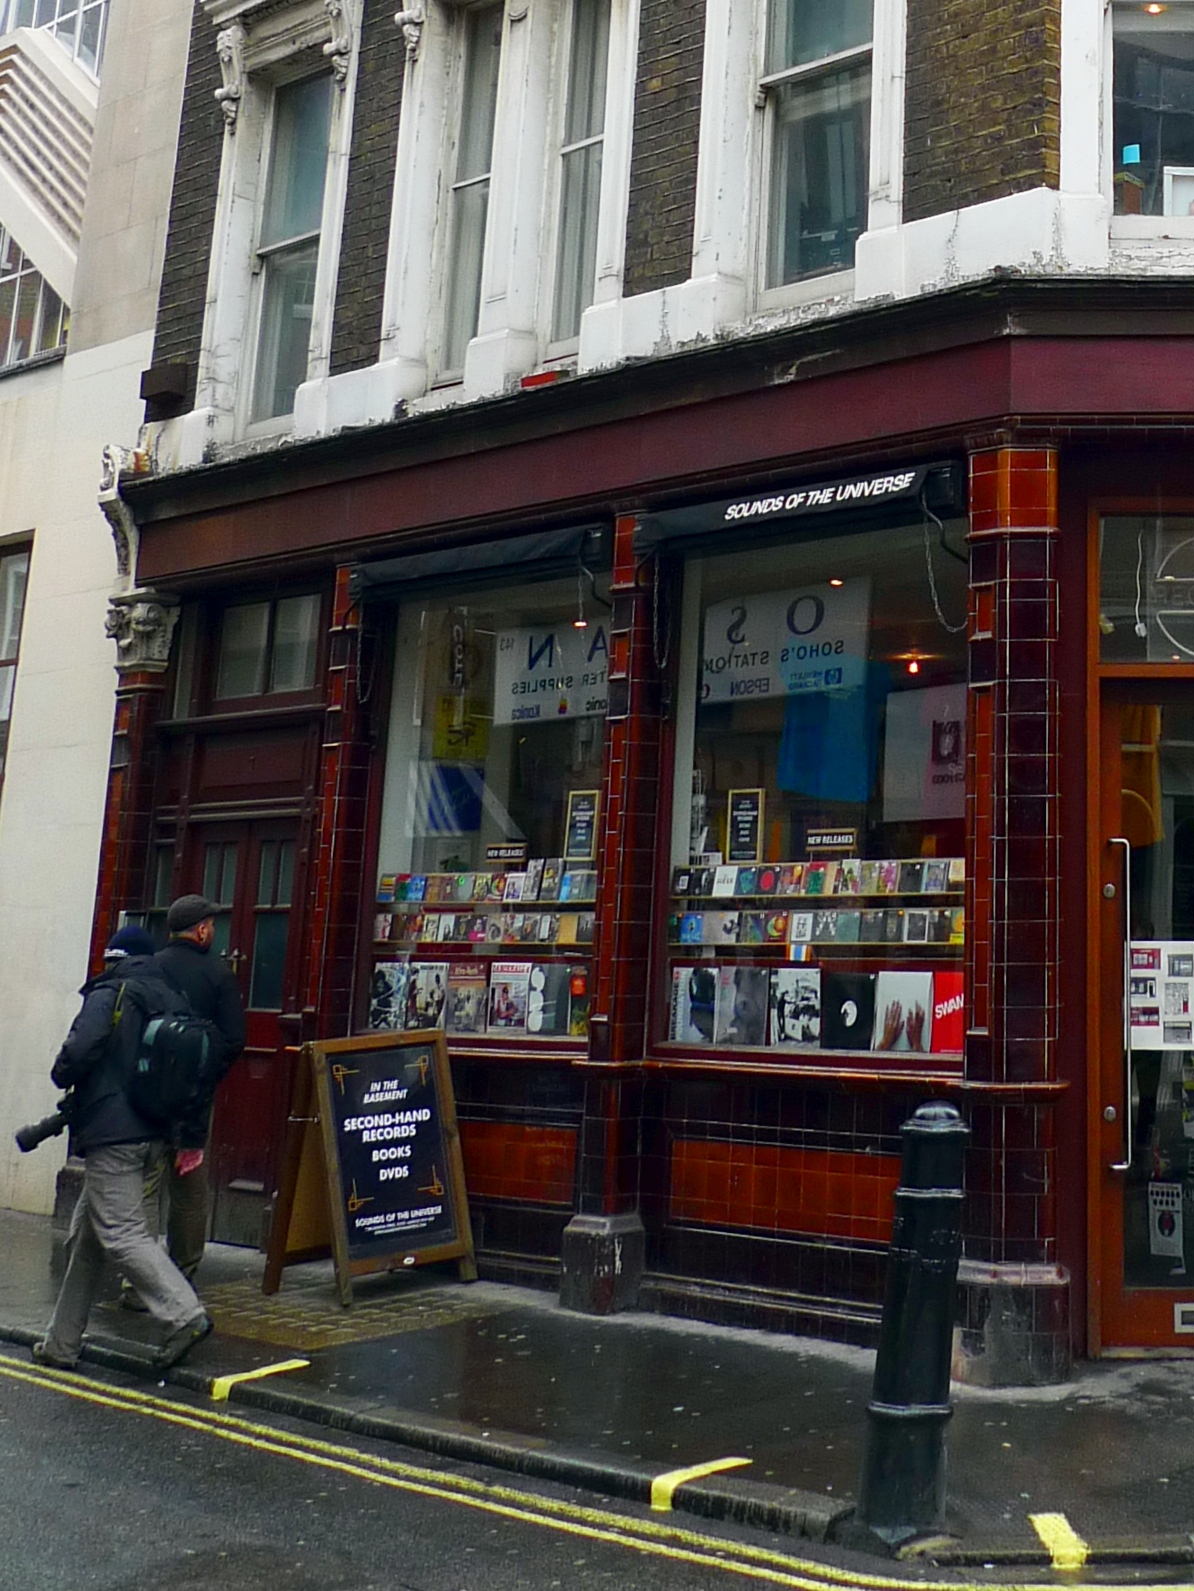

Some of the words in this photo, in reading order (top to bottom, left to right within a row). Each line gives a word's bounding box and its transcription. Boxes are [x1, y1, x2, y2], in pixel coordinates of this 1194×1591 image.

[724, 495, 784, 521] SOUNDS
[785, 492, 806, 509] OF
[806, 487, 836, 506] THE
[836, 472, 916, 502] UNIVERSE
[806, 836, 821, 846] NEW
[822, 833, 854, 845] RELEASES
[370, 1081, 382, 1092] IN
[383, 1079, 399, 1091] THE
[363, 1089, 409, 1104] BASEMENT
[343, 1109, 431, 1132] SECOND-HAND
[362, 1124, 417, 1143] RECORDS
[372, 1145, 412, 1162] BOOKS
[379, 1165, 409, 1181] DVDS
[355, 1213, 385, 1228] SOUNDS
[386, 1212, 396, 1222] OF
[397, 1210, 410, 1220] THE
[410, 1205, 442, 1218] UNIVERSE
